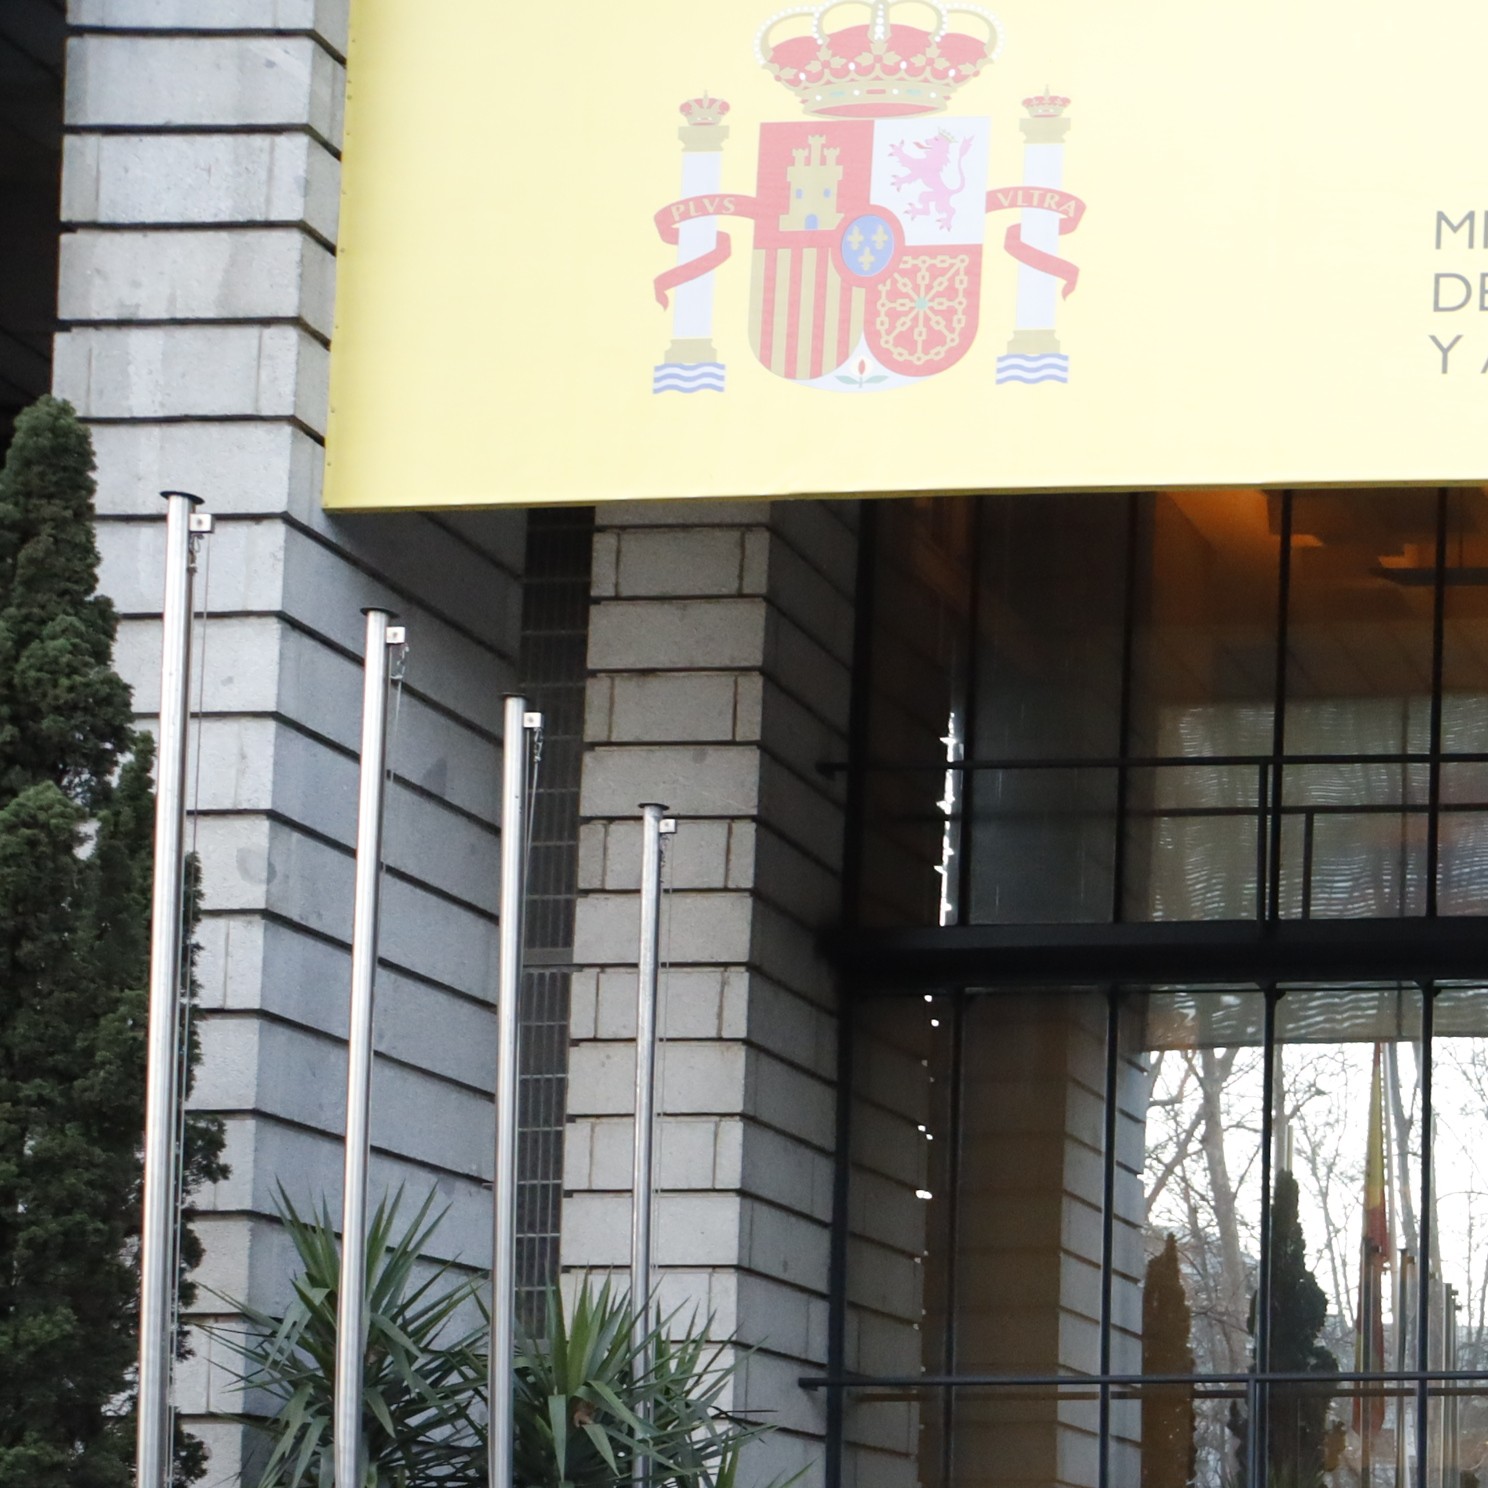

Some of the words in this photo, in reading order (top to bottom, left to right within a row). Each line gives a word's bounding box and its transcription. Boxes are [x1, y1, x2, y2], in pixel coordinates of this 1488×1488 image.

[671, 196, 736, 222] PLVS
[996, 189, 1077, 218] VLTRA
[1428, 335, 1464, 375] Y
